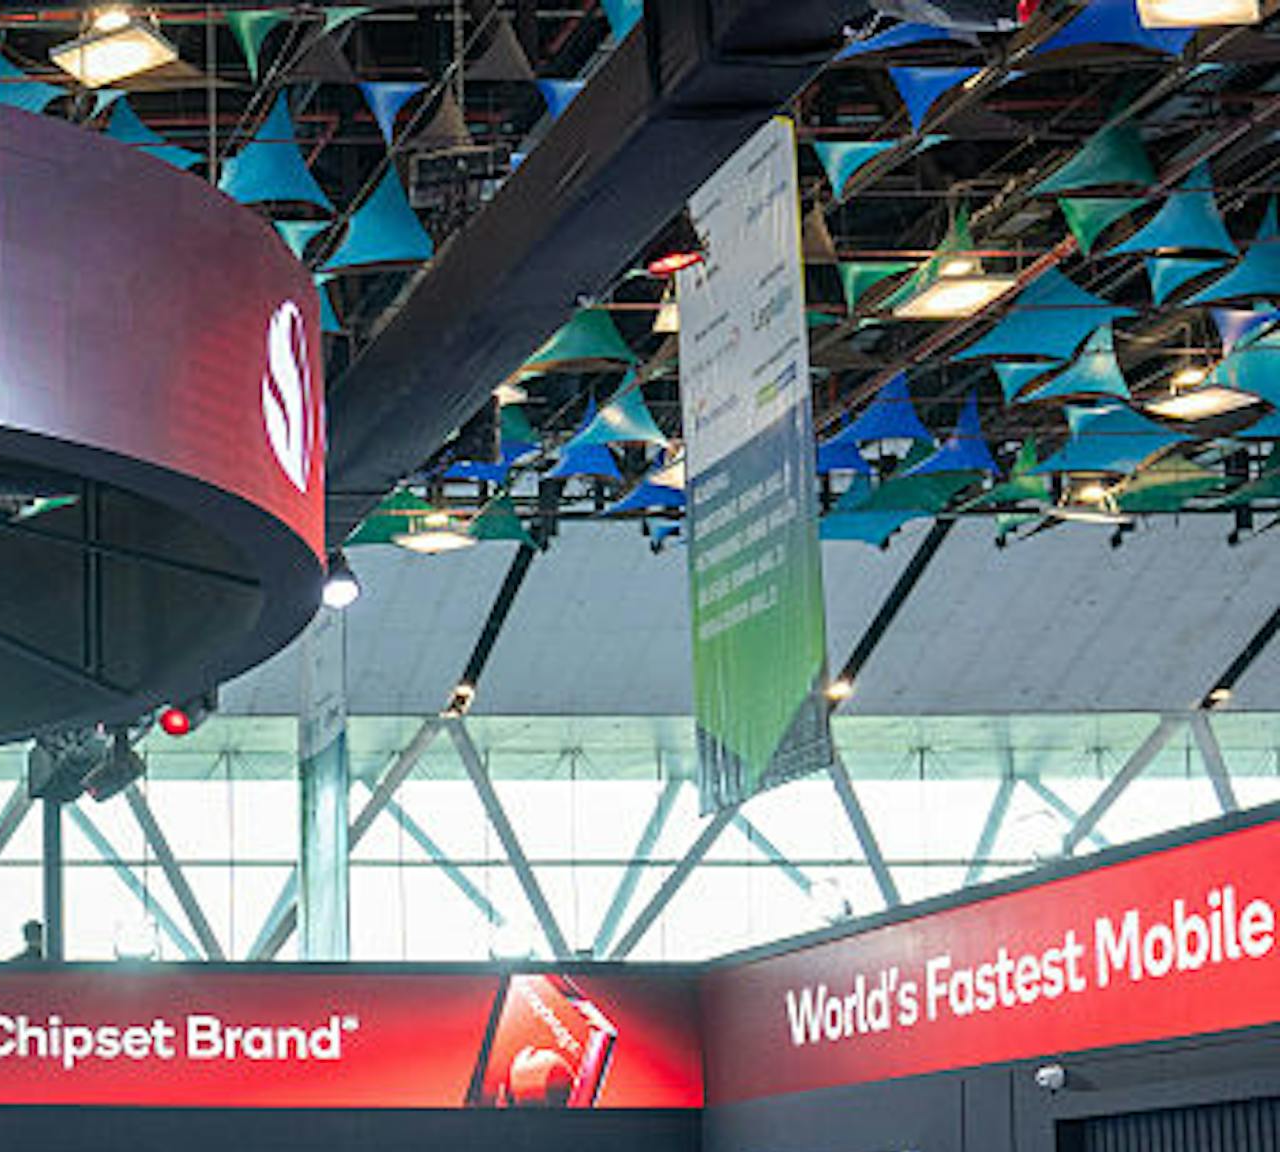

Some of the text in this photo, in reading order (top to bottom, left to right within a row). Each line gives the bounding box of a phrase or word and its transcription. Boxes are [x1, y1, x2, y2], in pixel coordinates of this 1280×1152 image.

[785, 883, 1276, 1046] World's Fastest Mobile
